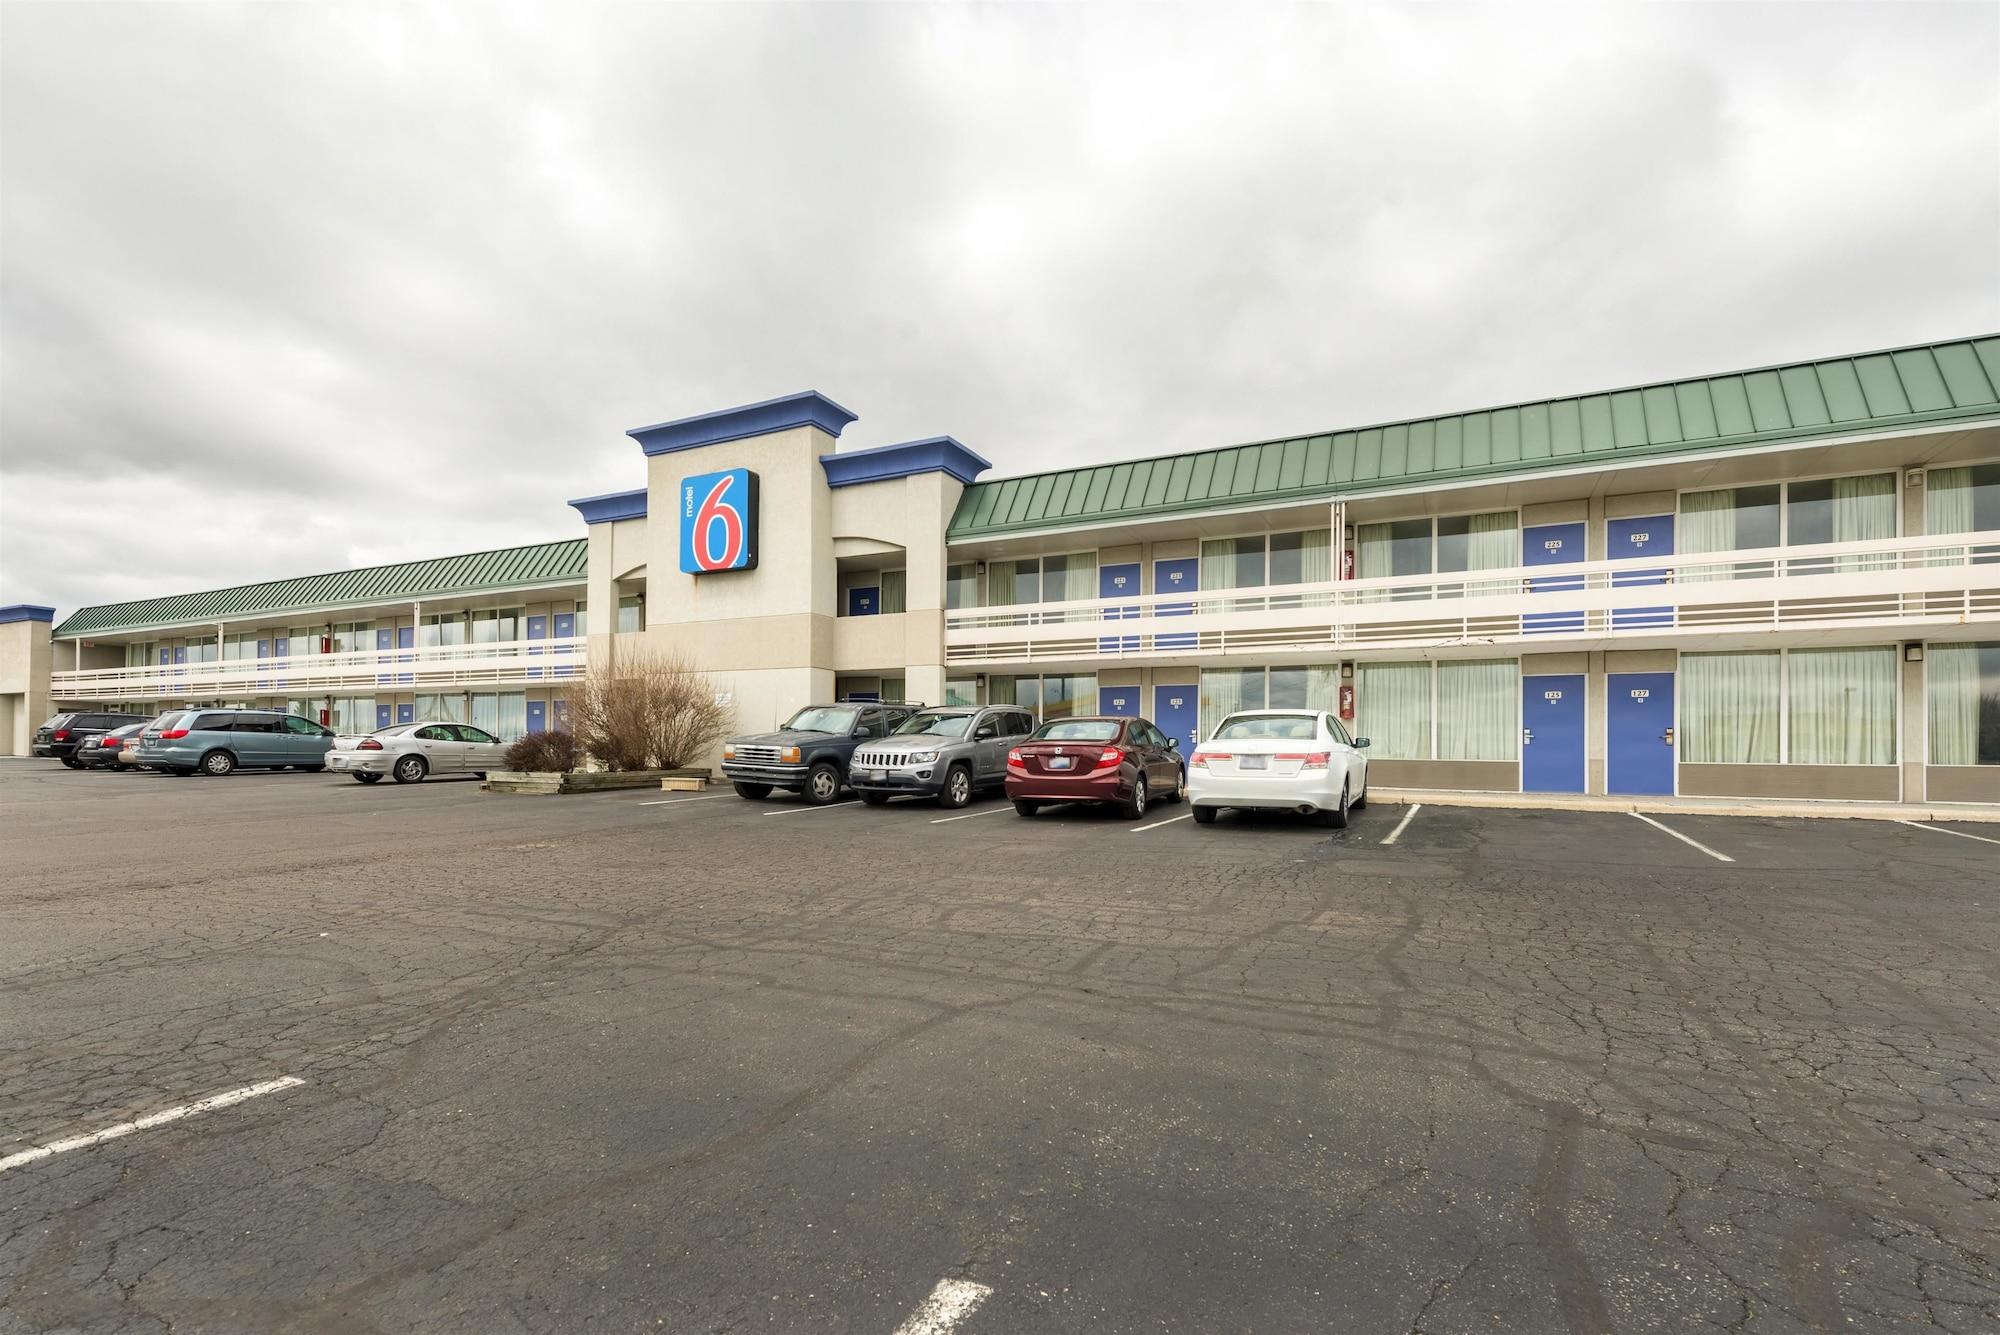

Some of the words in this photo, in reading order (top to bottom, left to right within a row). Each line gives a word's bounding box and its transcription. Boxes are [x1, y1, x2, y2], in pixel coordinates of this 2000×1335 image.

[685, 486, 694, 518] motel
[692, 475, 744, 571] 6
[1546, 540, 1561, 548] 225
